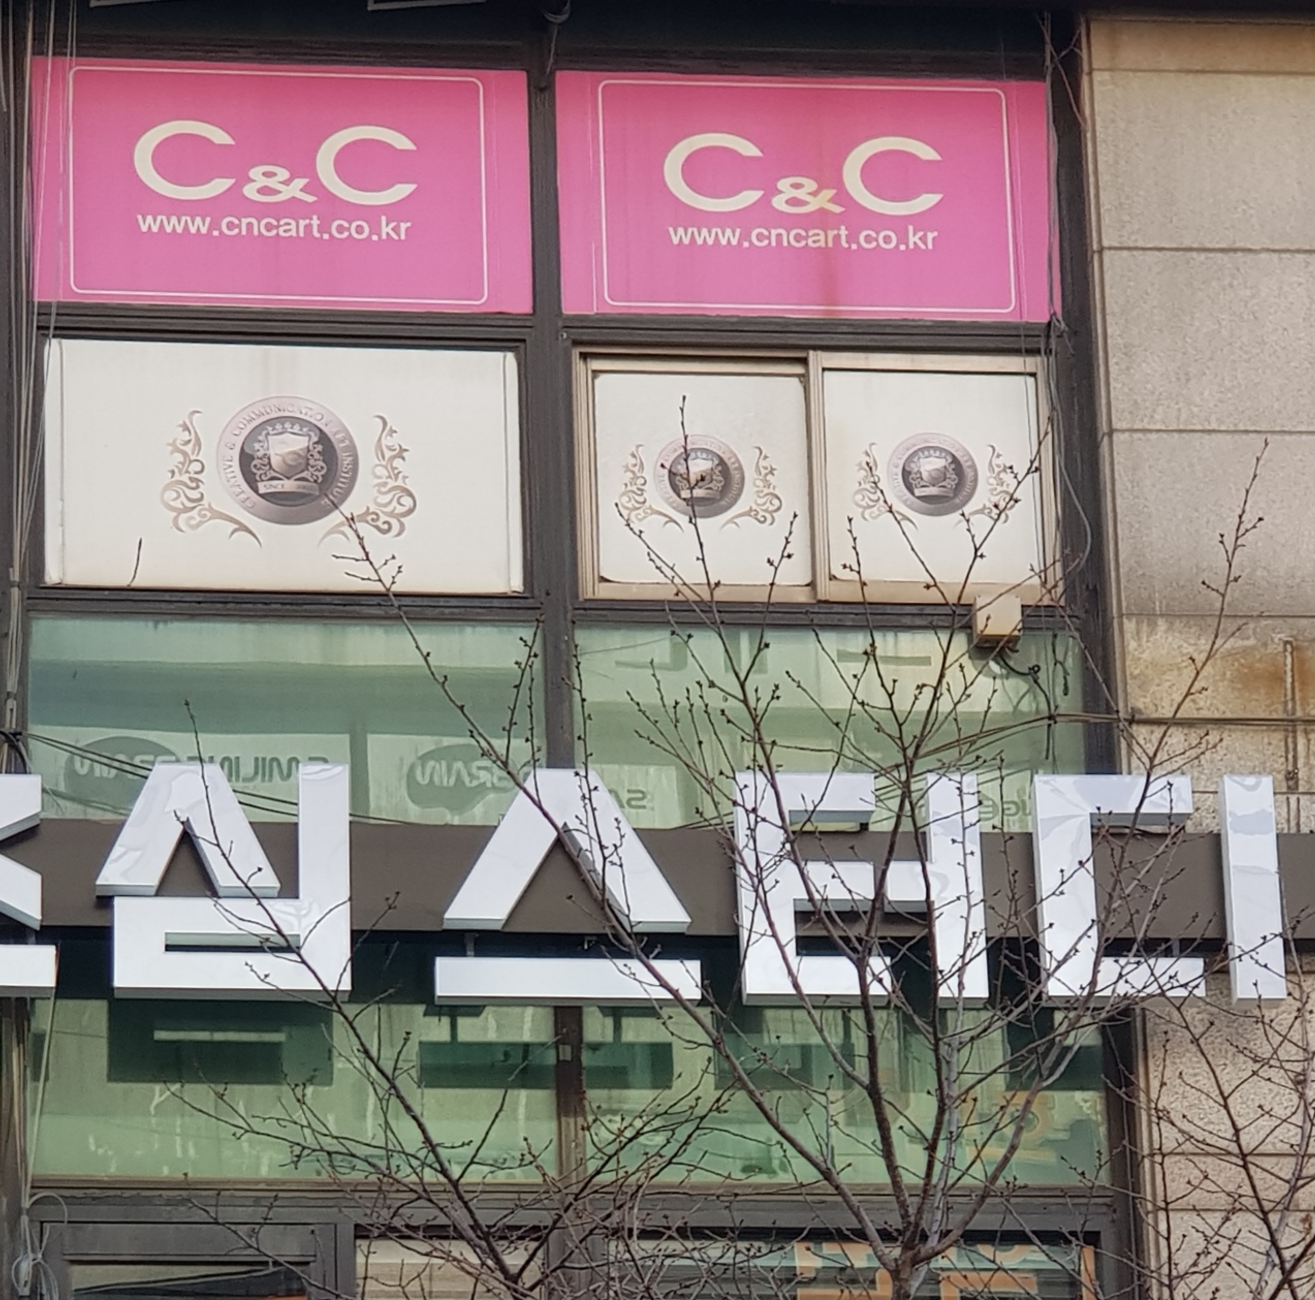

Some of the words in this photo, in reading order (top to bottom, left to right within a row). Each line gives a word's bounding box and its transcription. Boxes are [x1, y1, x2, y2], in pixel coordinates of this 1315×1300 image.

[133, 120, 417, 205] C&C
[663, 132, 943, 215] C&C
[137, 214, 411, 242] www.cncart.co.kr
[668, 225, 937, 251] www.cncart.co.kr
